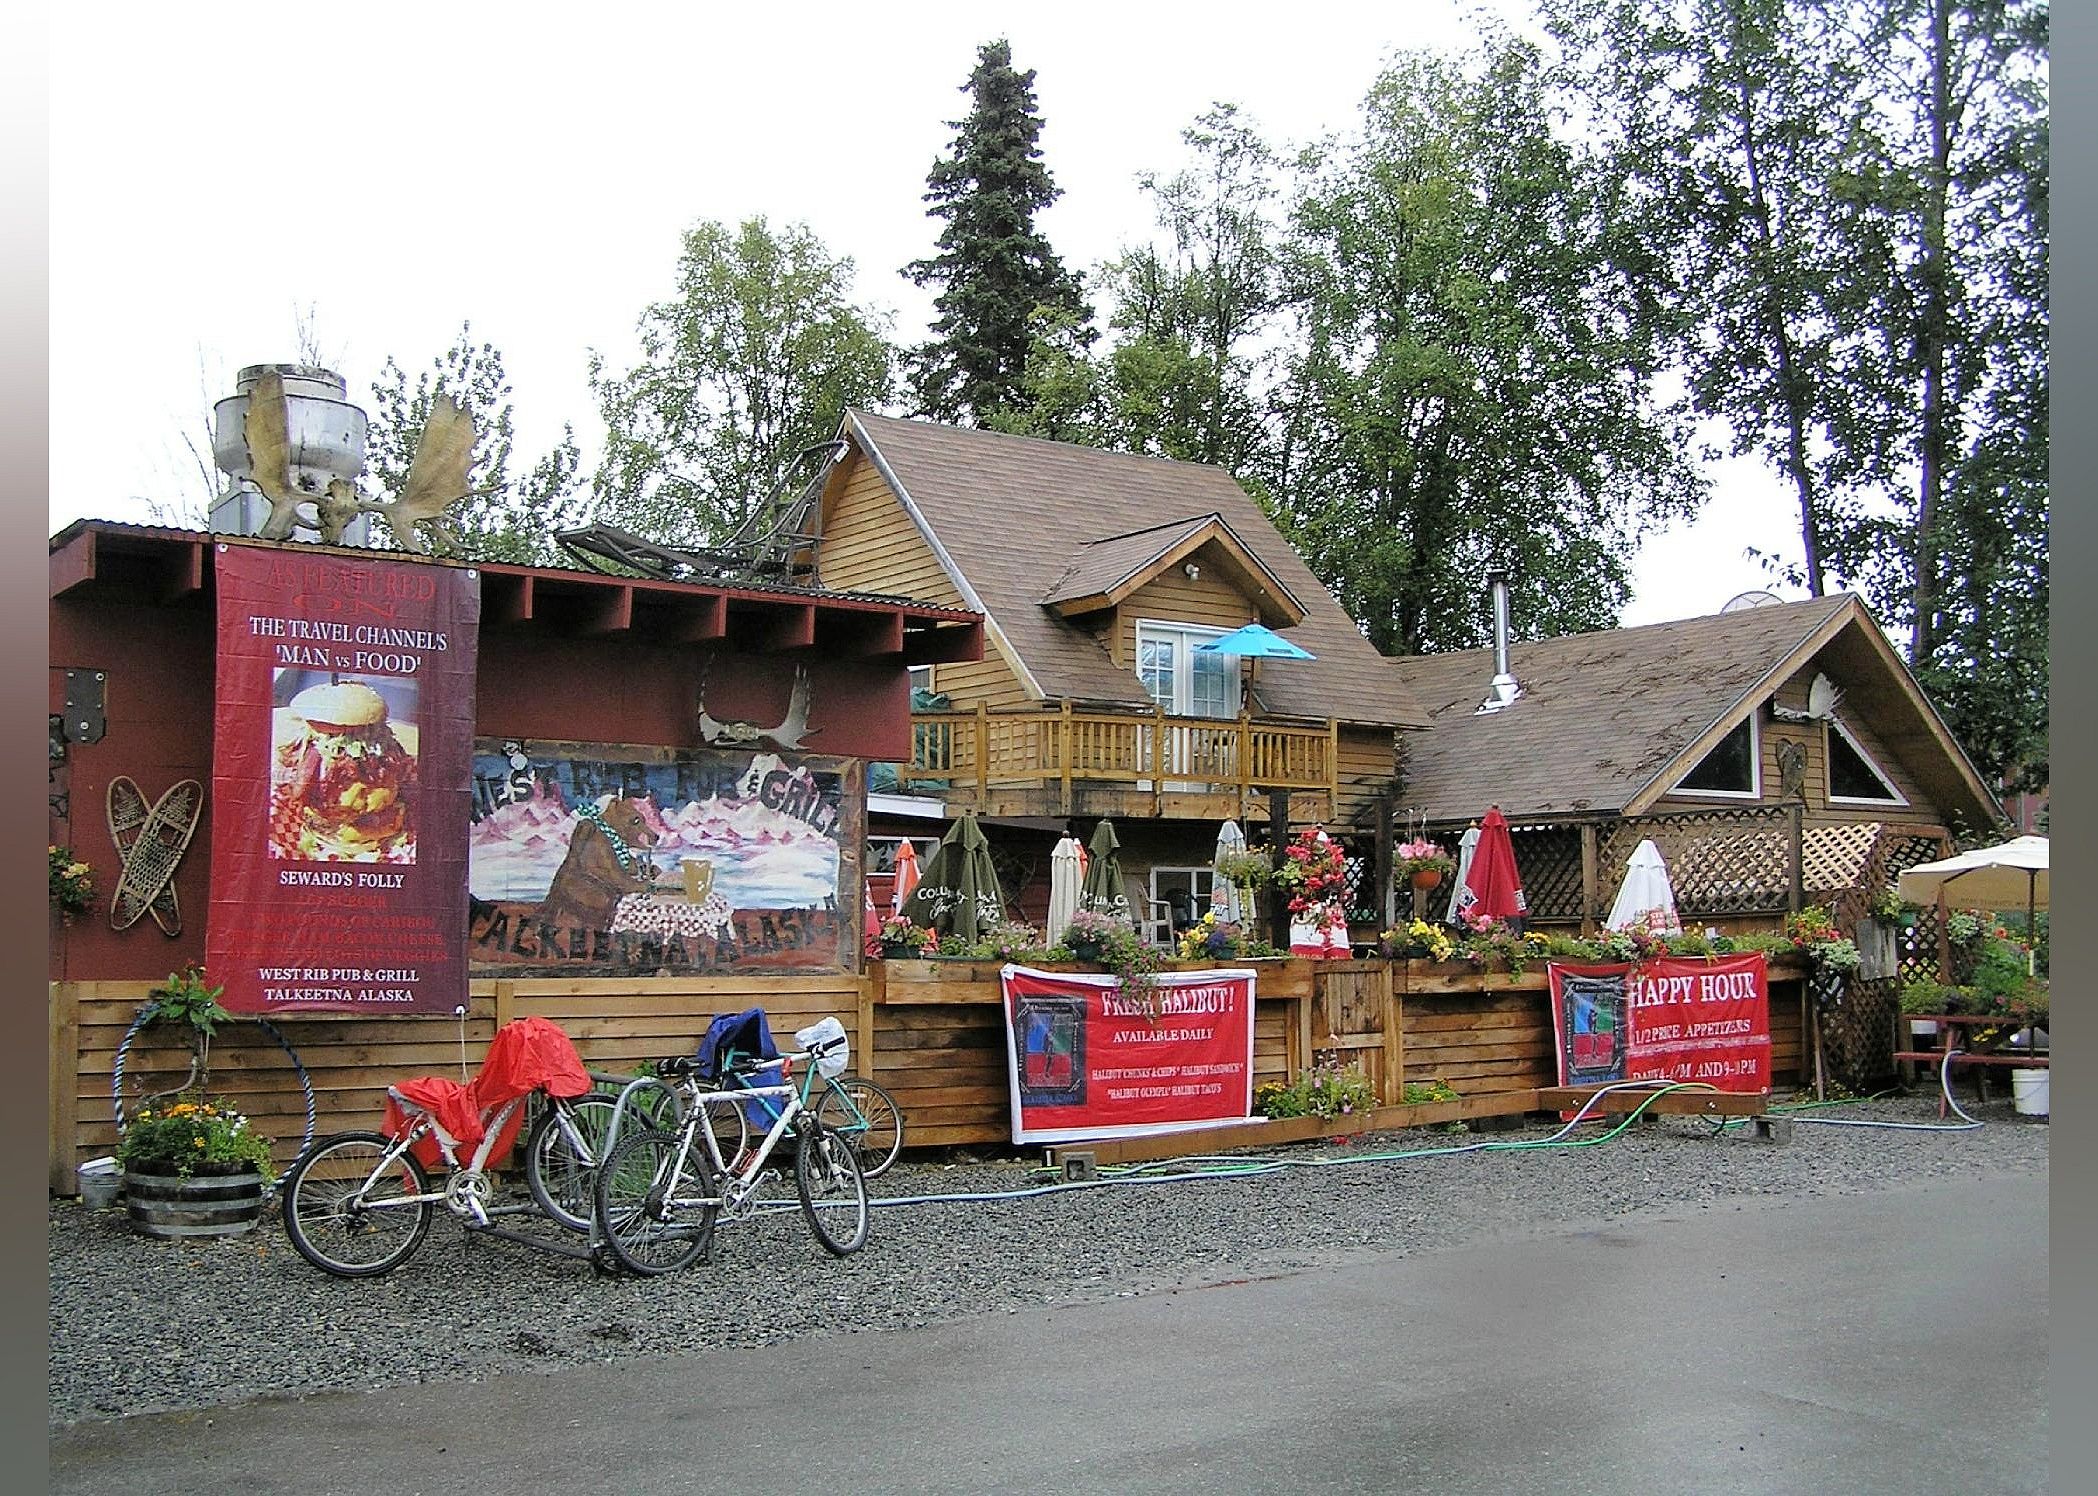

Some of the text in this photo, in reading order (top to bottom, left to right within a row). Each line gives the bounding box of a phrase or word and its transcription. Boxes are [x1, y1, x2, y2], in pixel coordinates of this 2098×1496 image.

[249, 616, 448, 651] THE TRAVEL CHANNEL'S
[280, 871, 405, 889] SEWARD'S FOLLY
[259, 967, 420, 983] WEST RIB PUB & GRILL
[263, 988, 415, 1002] TALKEETNA ALASKA
[1629, 971, 1757, 1009] HAPPY HOUR
[1113, 1027, 1214, 1044] AVAILABLE DAILY
[1684, 1019, 1751, 1038] APPETIZERS
[1695, 1061, 1723, 1078] AND
